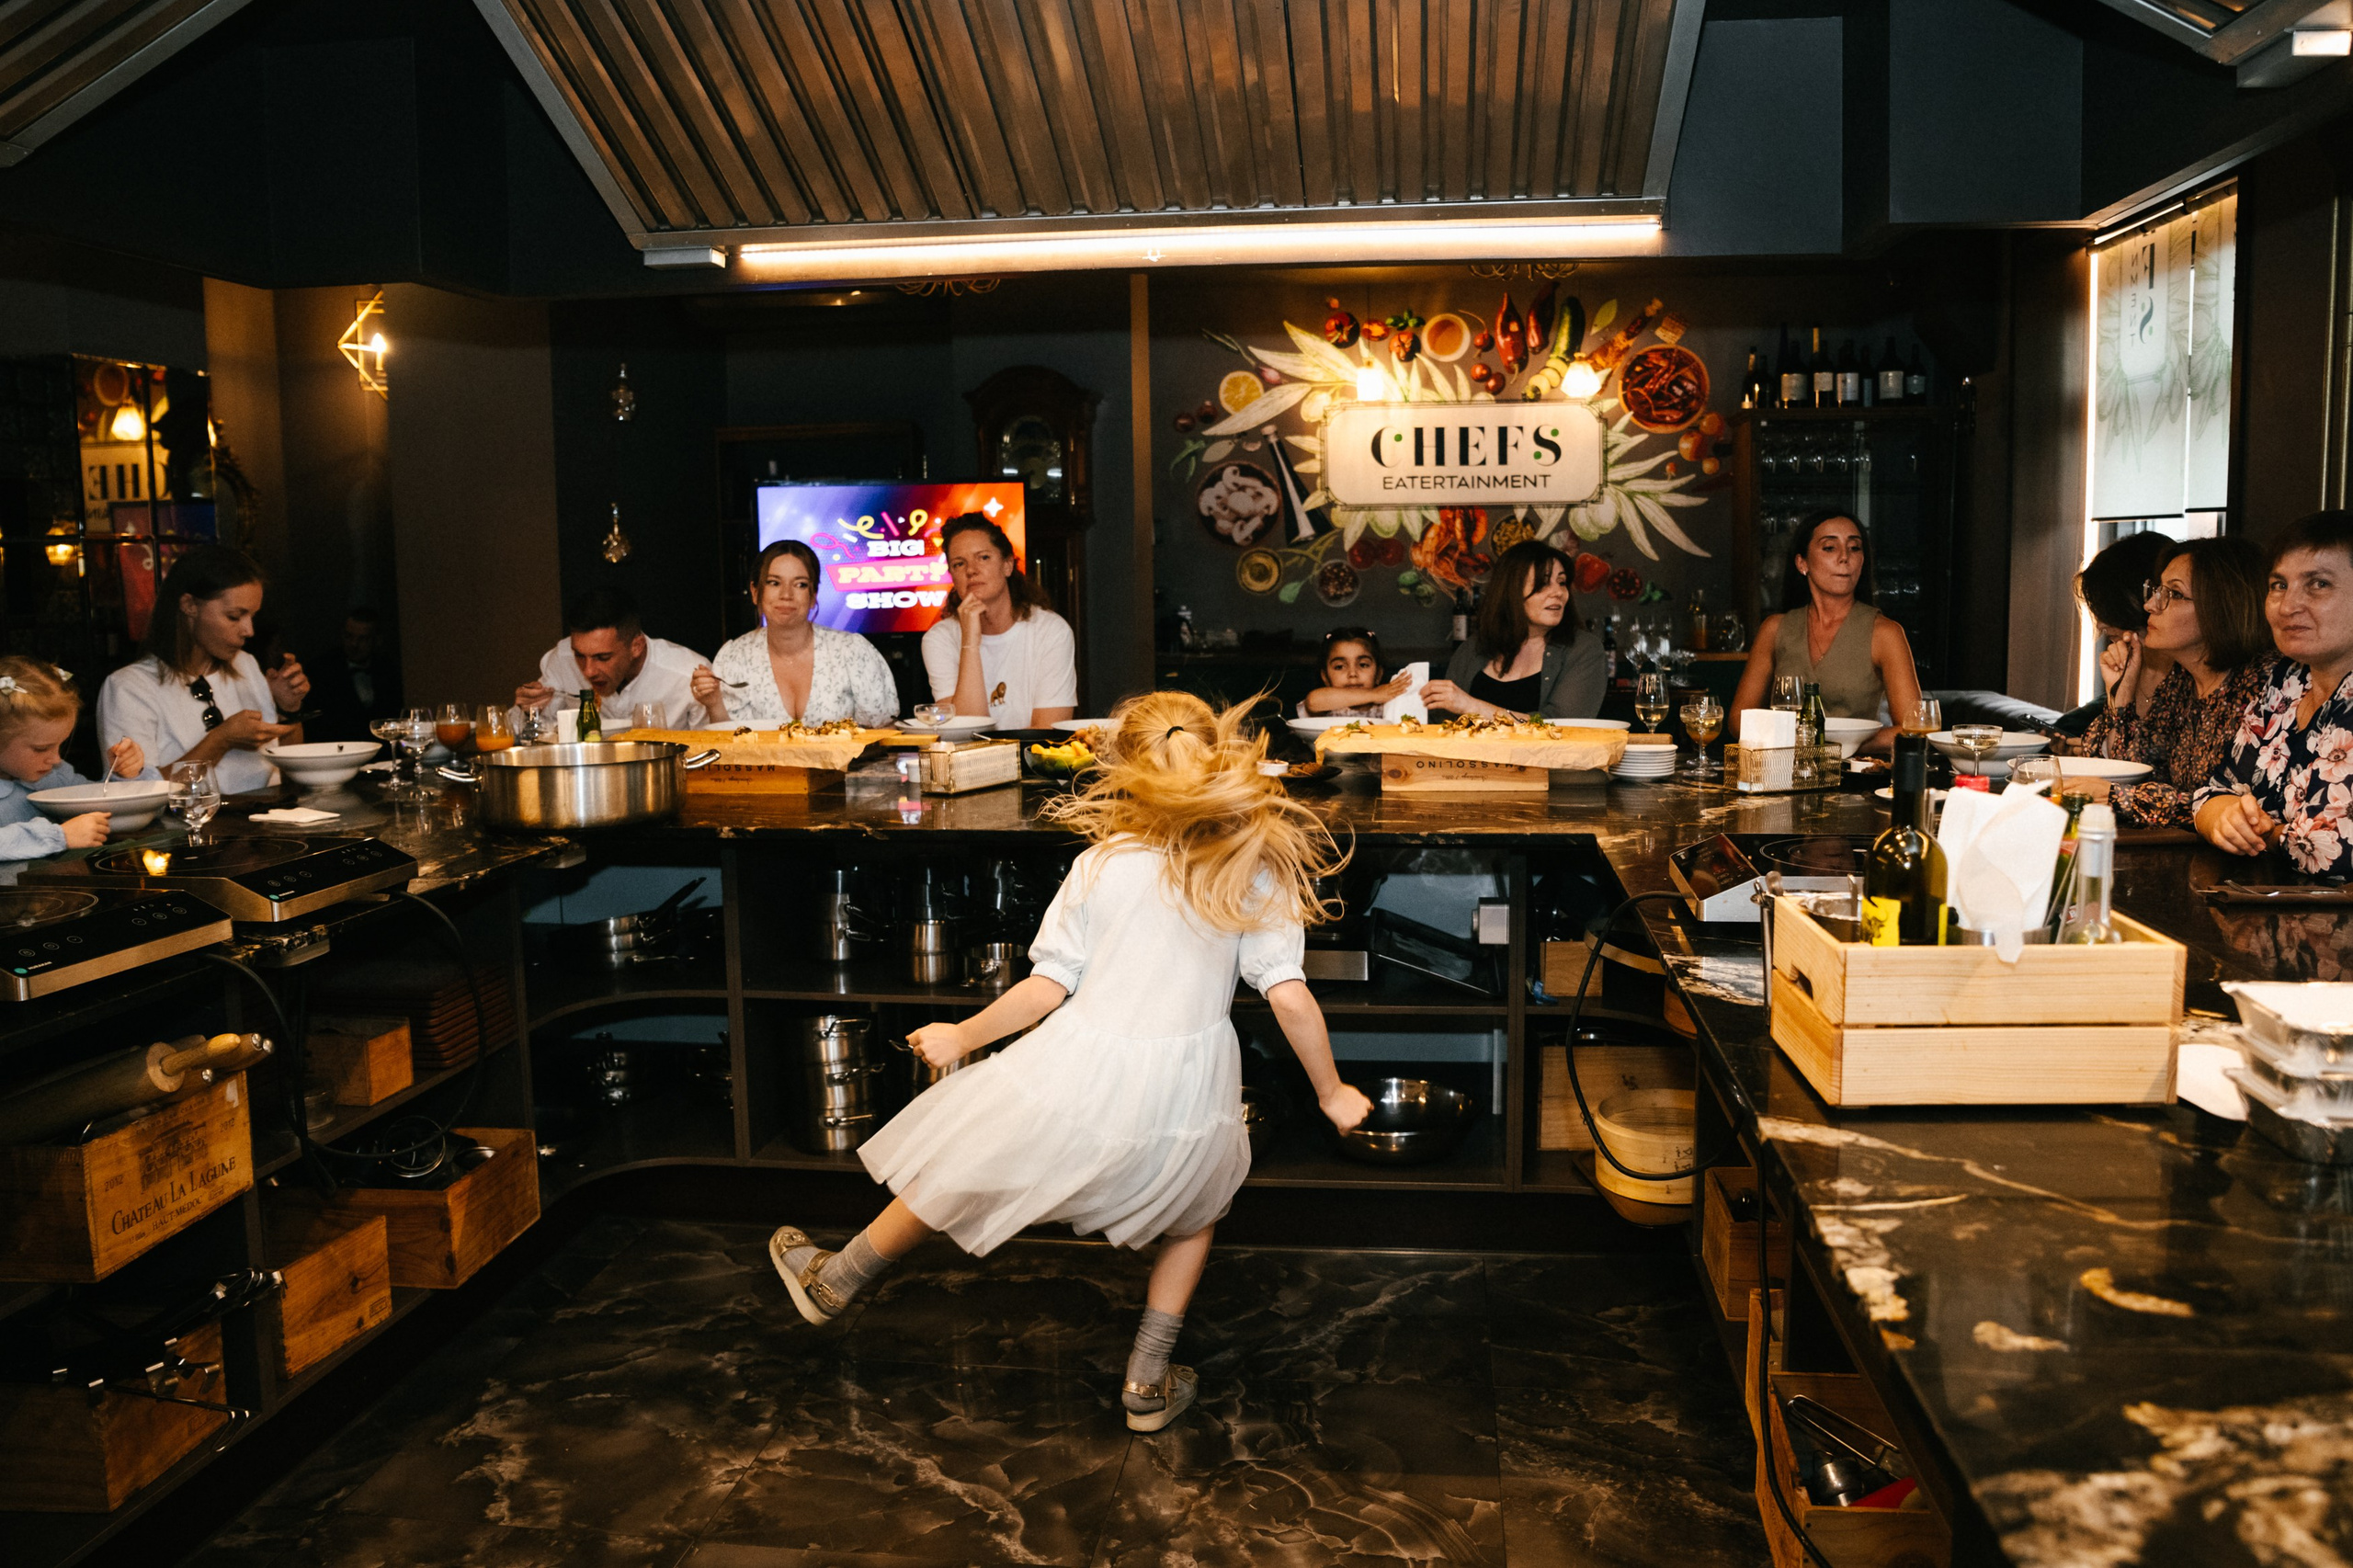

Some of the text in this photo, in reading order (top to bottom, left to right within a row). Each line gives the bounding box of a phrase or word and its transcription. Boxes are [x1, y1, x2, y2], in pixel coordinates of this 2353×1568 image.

[1371, 425, 1562, 468] CHEFS
[1383, 474, 1551, 490] EATERTAINMENT
[867, 540, 925, 557] BIG
[837, 562, 949, 584] PARTY
[846, 591, 948, 609] SHOW
[696, 764, 776, 772] MASSOLIN
[104, 1174, 124, 1192] 2012
[169, 1180, 187, 1204] LA
[189, 1156, 236, 1193] LAGUNE
